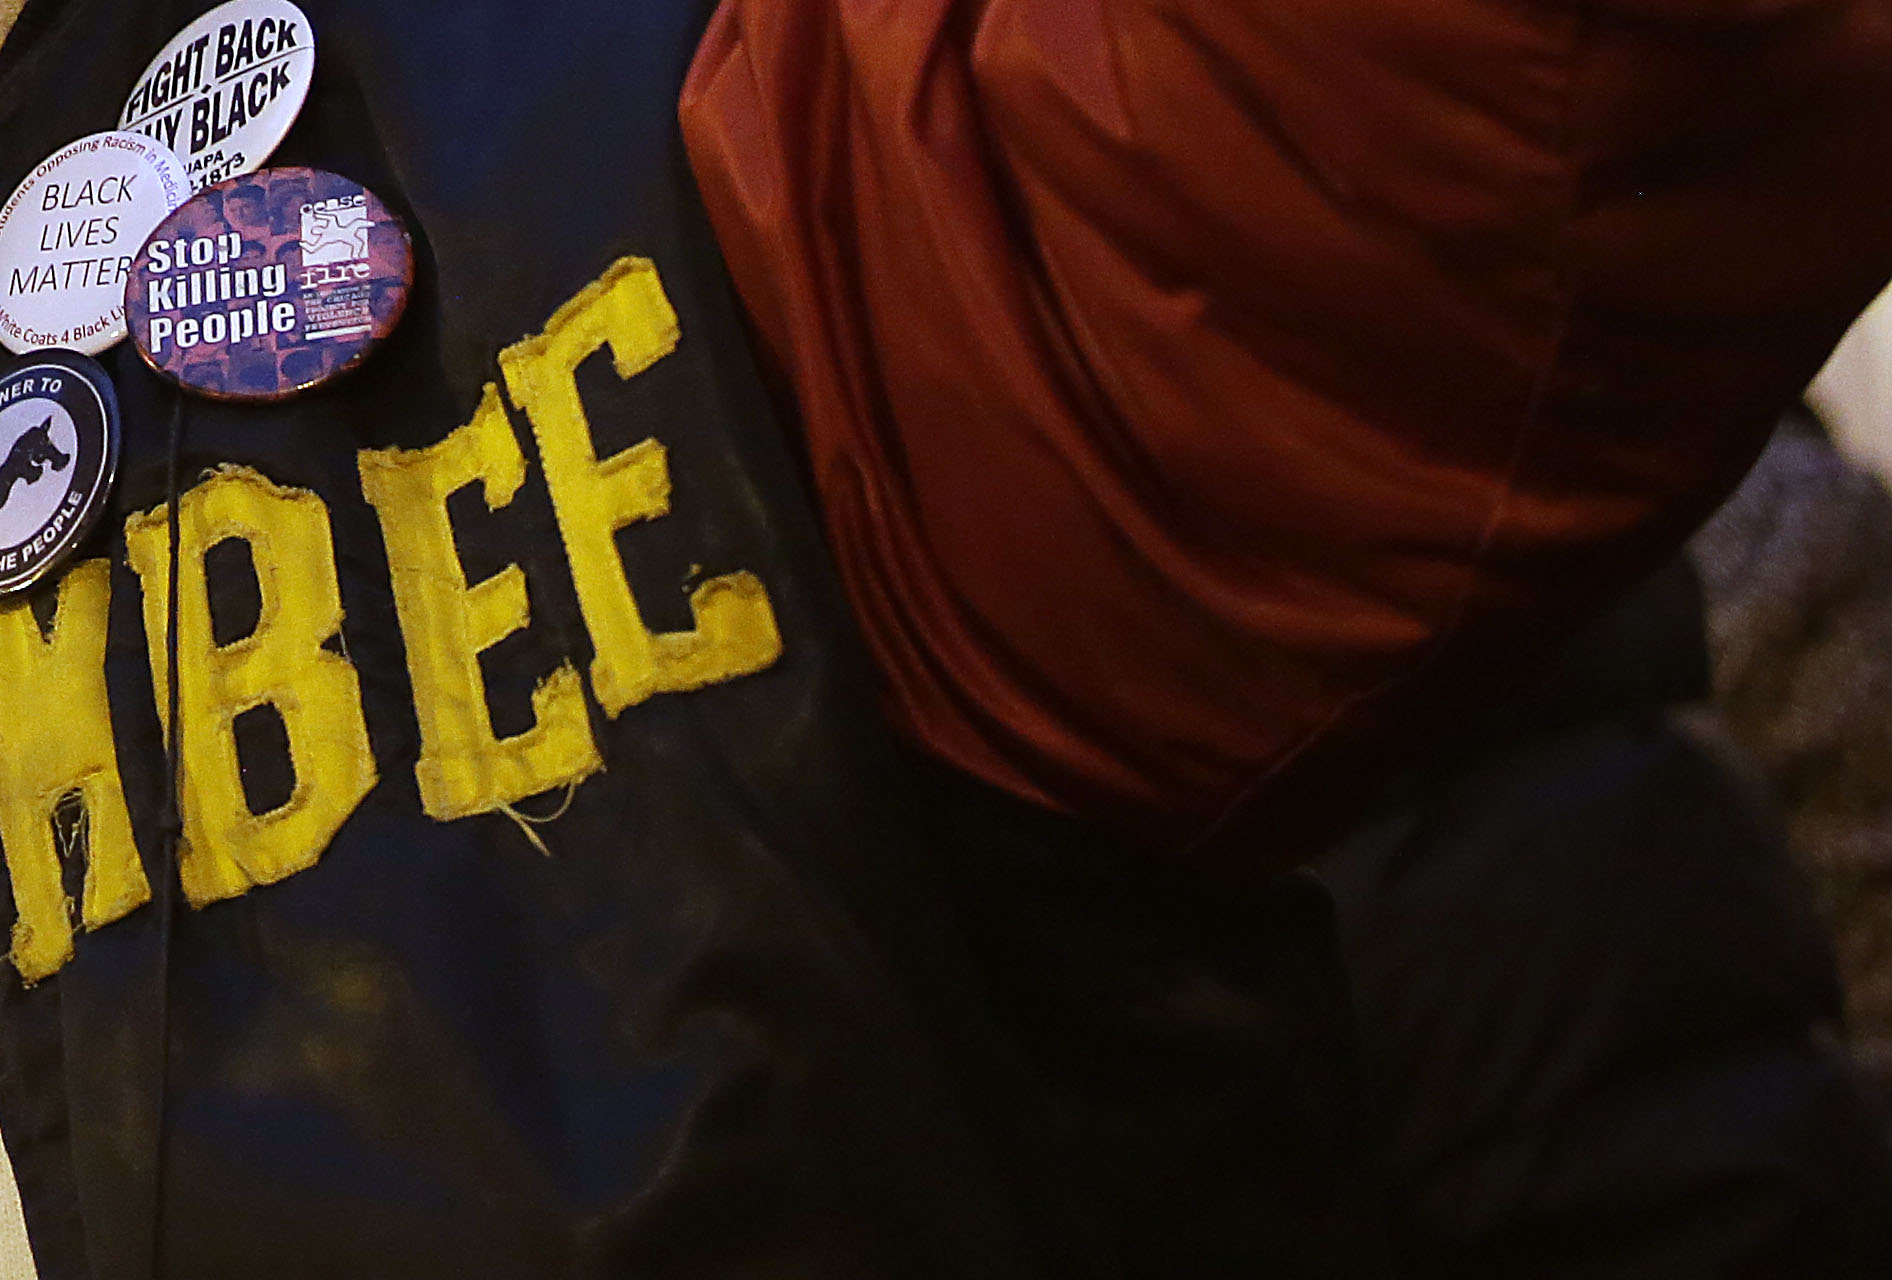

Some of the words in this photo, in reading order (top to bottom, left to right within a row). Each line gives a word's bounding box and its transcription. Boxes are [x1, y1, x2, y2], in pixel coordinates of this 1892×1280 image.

[126, 34, 209, 123] FIGHT
[216, 17, 297, 80] BACK
[190, 62, 291, 154] BLACK
[36, 140, 99, 178] Opposing
[103, 136, 146, 156] Racism
[146, 150, 158, 163] in
[154, 157, 180, 211] Medicin
[41, 173, 138, 212] BLACK
[40, 216, 120, 252] LIVES
[148, 231, 242, 274] Stop
[9, 255, 133, 296] MATTER
[148, 264, 286, 313] Killing
[22, 328, 58, 346] Coats
[61, 332, 69, 345] 4
[73, 315, 111, 341] Black
[150, 300, 296, 354] People
[40, 377, 63, 393] TO
[21, 490, 83, 562] PEOPLE
